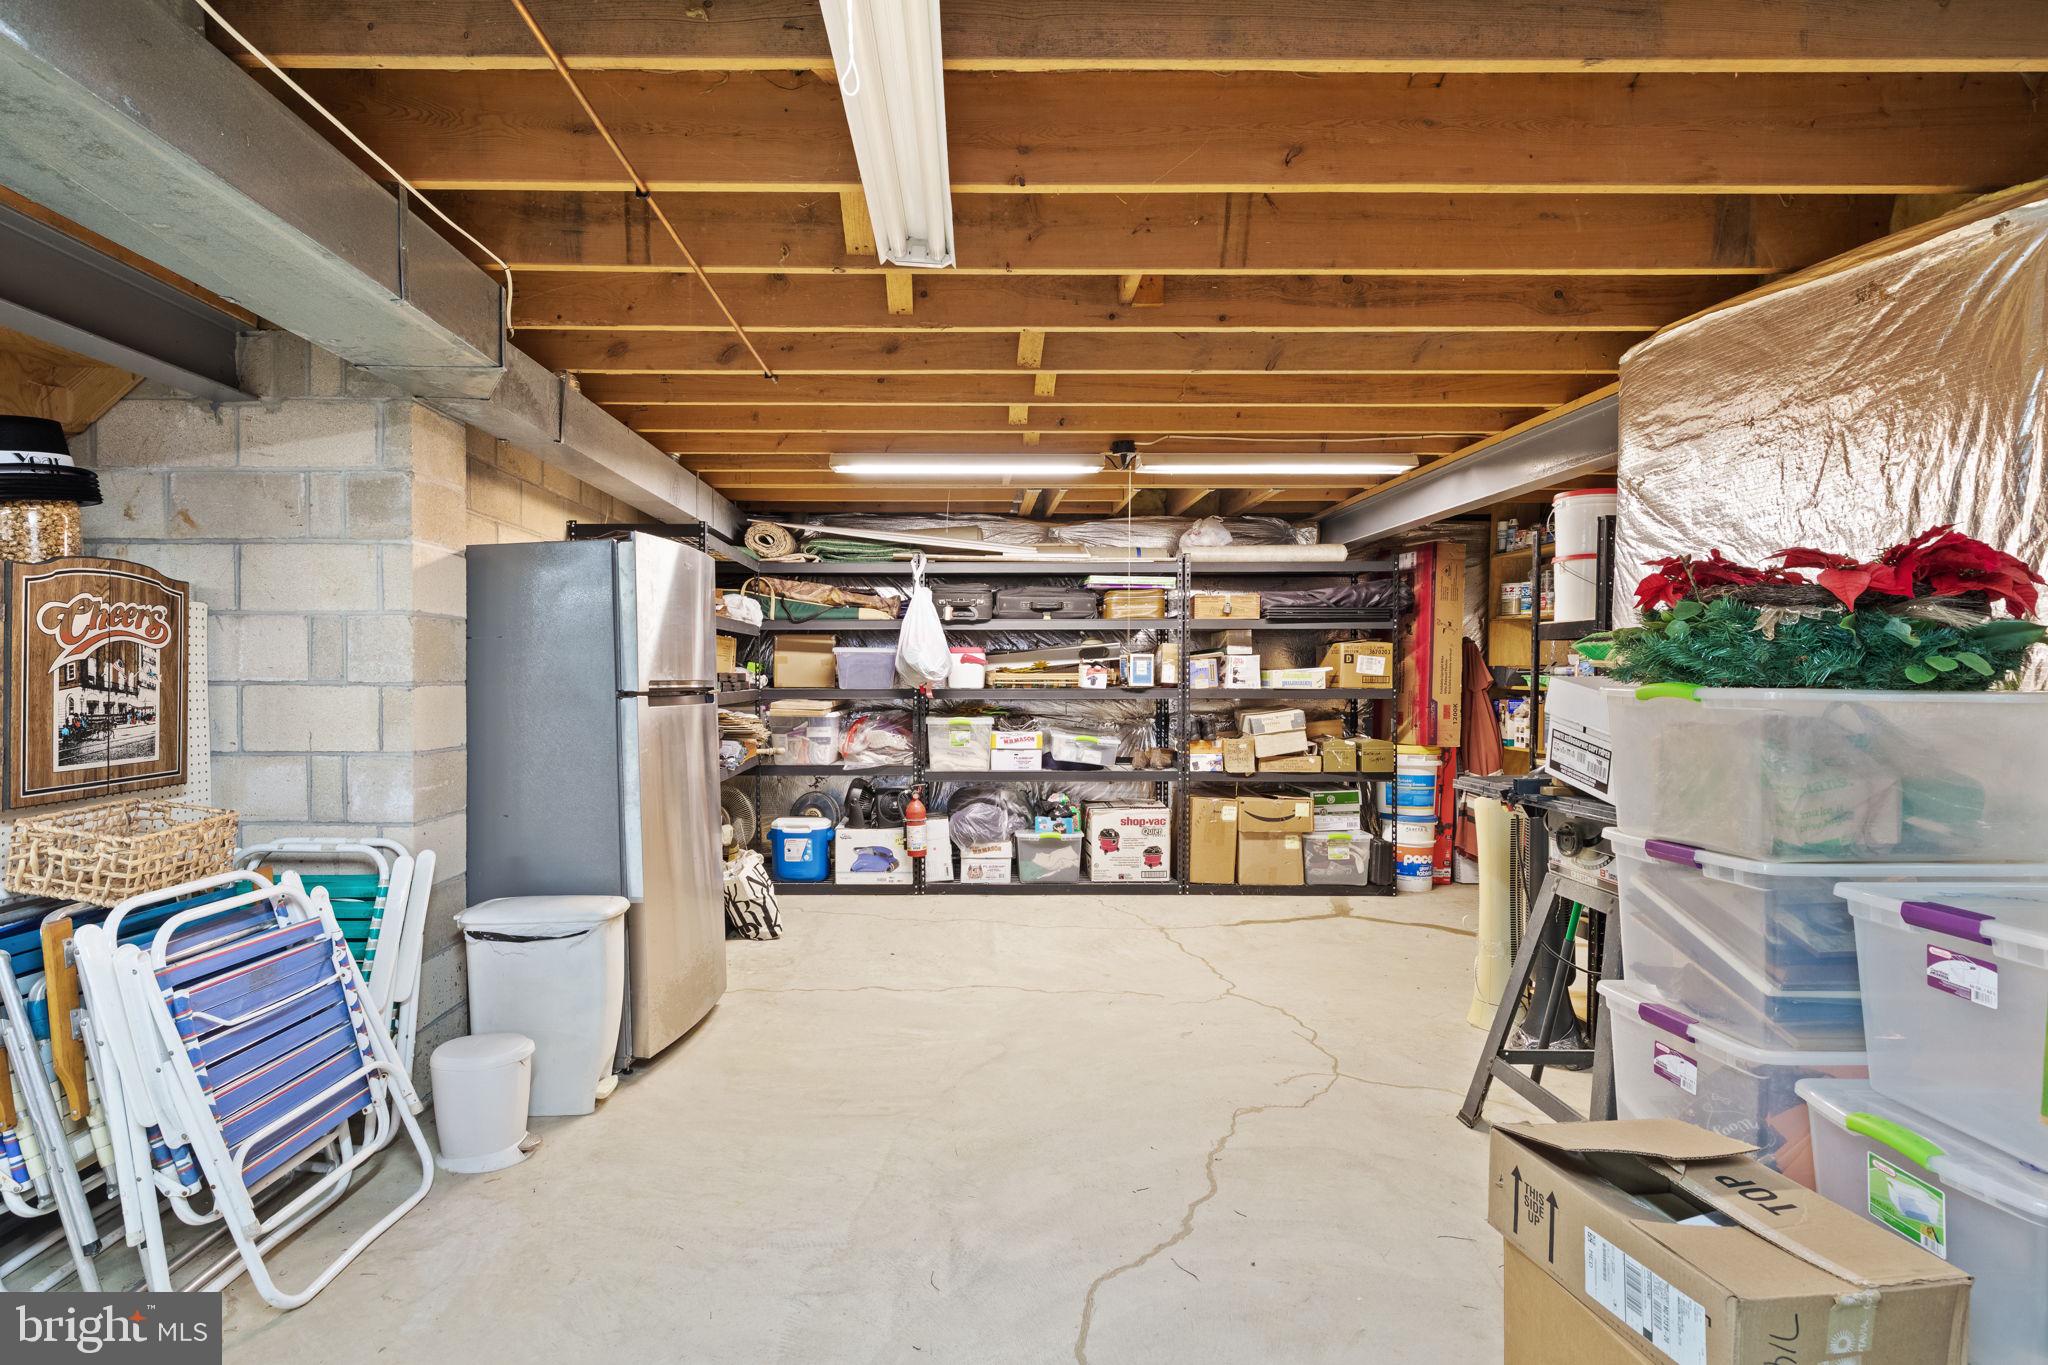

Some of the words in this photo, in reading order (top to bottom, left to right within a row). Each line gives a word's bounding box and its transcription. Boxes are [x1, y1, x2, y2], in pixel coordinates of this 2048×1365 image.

[38, 594, 172, 650] Cheers
[1524, 1182, 1544, 1206] THIS
[1524, 1194, 1544, 1219] SIDE
[1714, 1175, 1798, 1216] TOP
[1528, 1209, 1540, 1226] UP
